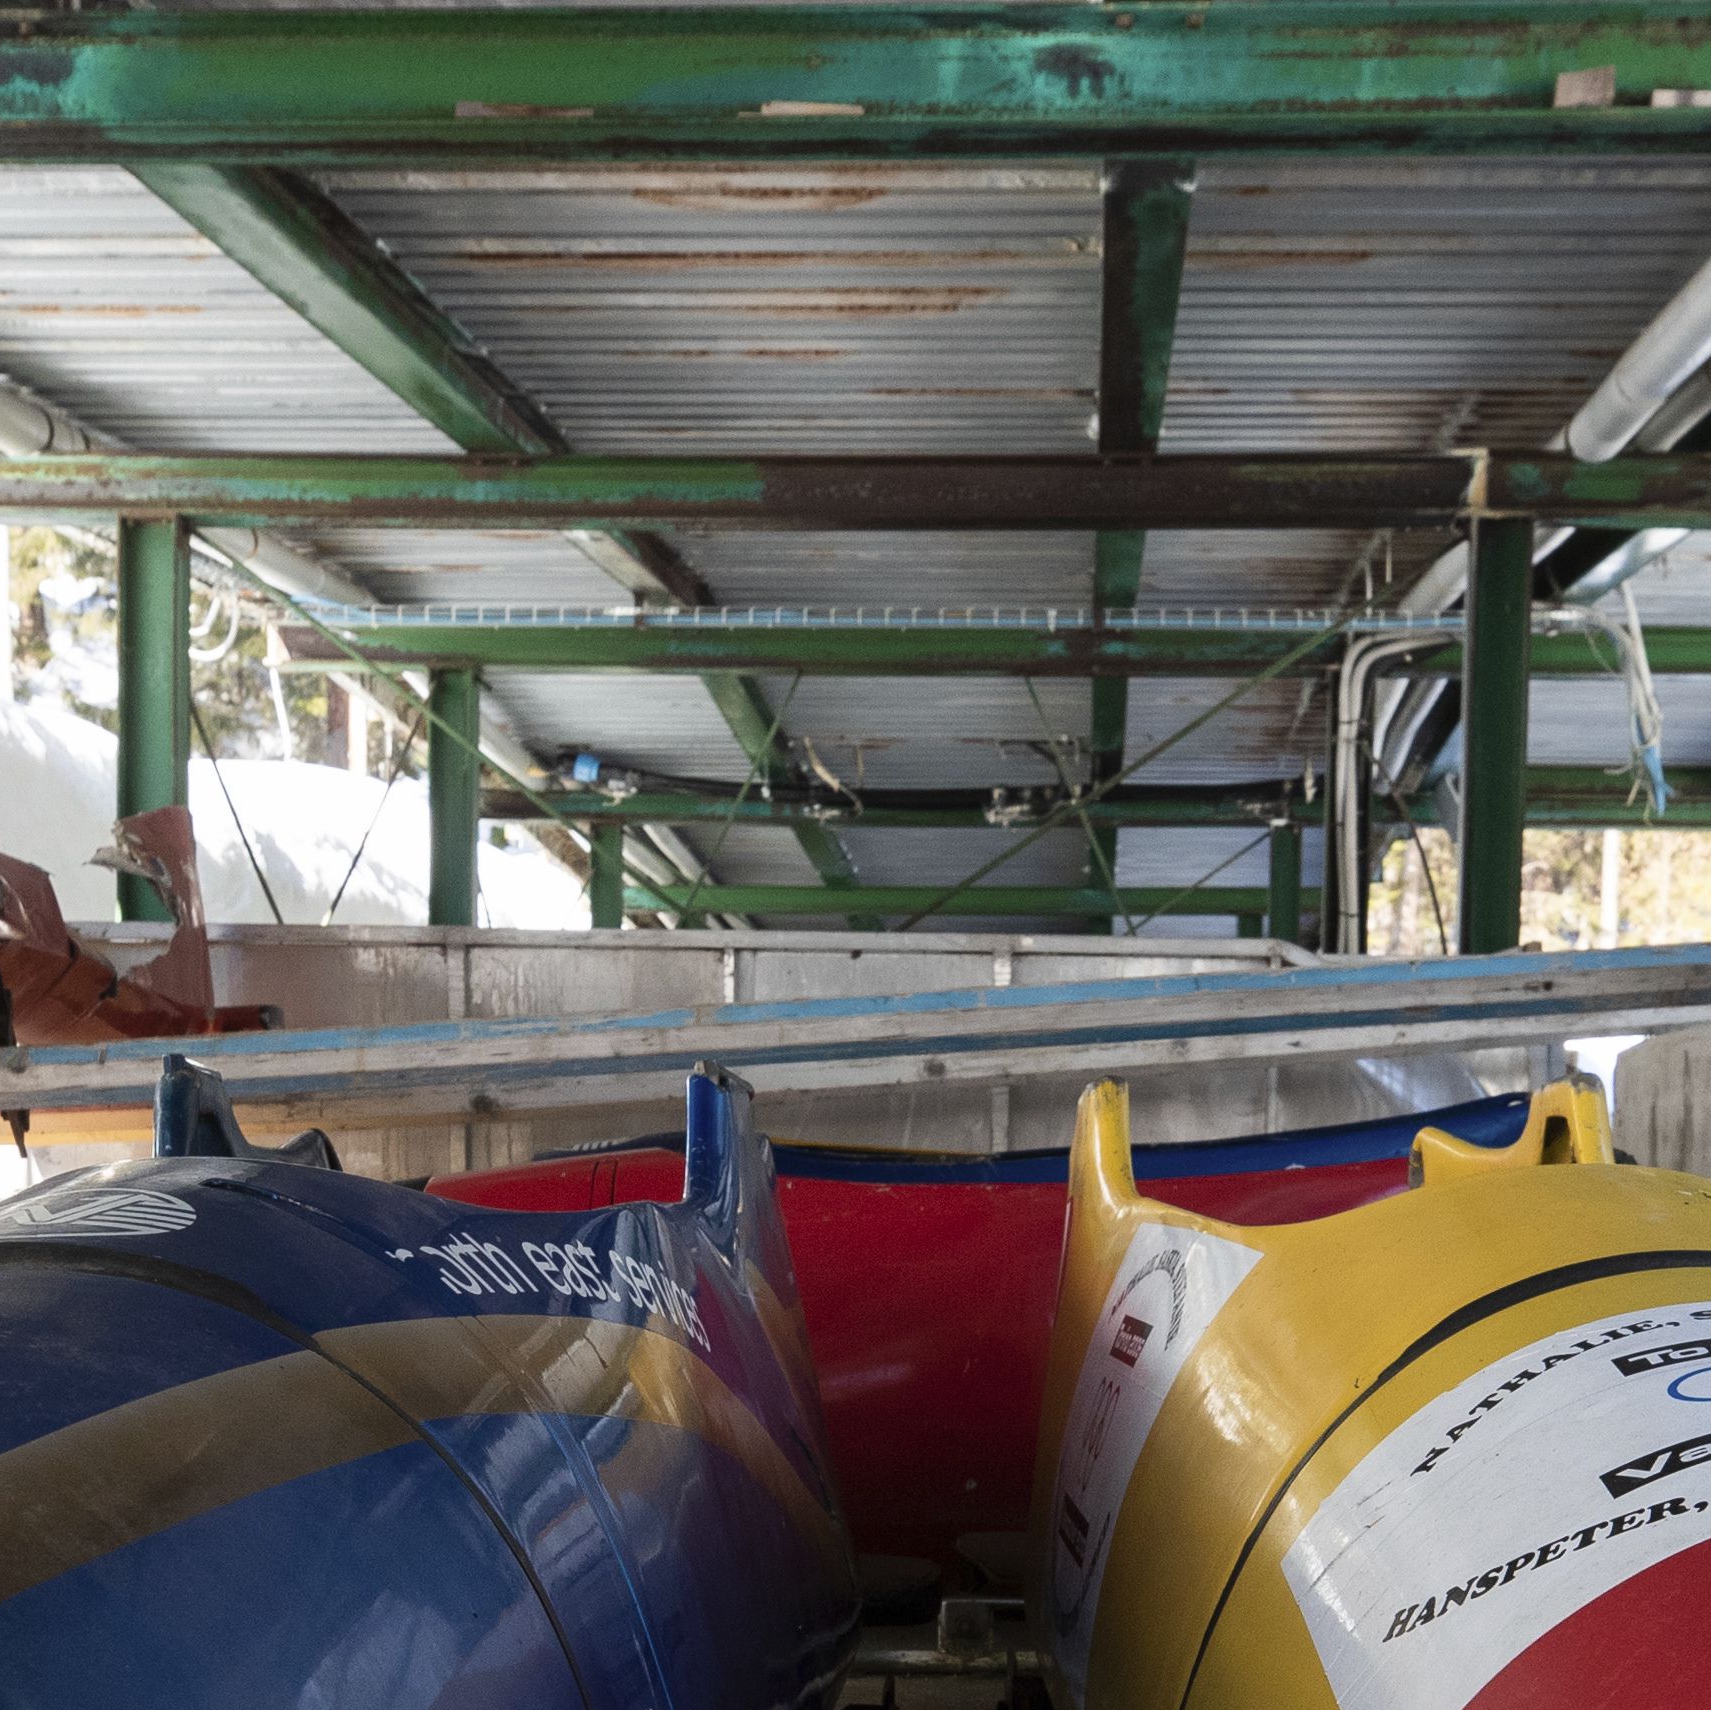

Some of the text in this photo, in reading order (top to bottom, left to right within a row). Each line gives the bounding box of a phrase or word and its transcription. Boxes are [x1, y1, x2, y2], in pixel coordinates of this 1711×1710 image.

[521, 1238, 622, 1303] east
[608, 1249, 711, 1353] services
[1409, 1319, 1681, 1477] NATHALIE,
[1381, 1497, 1709, 1643] HANSPETER,
